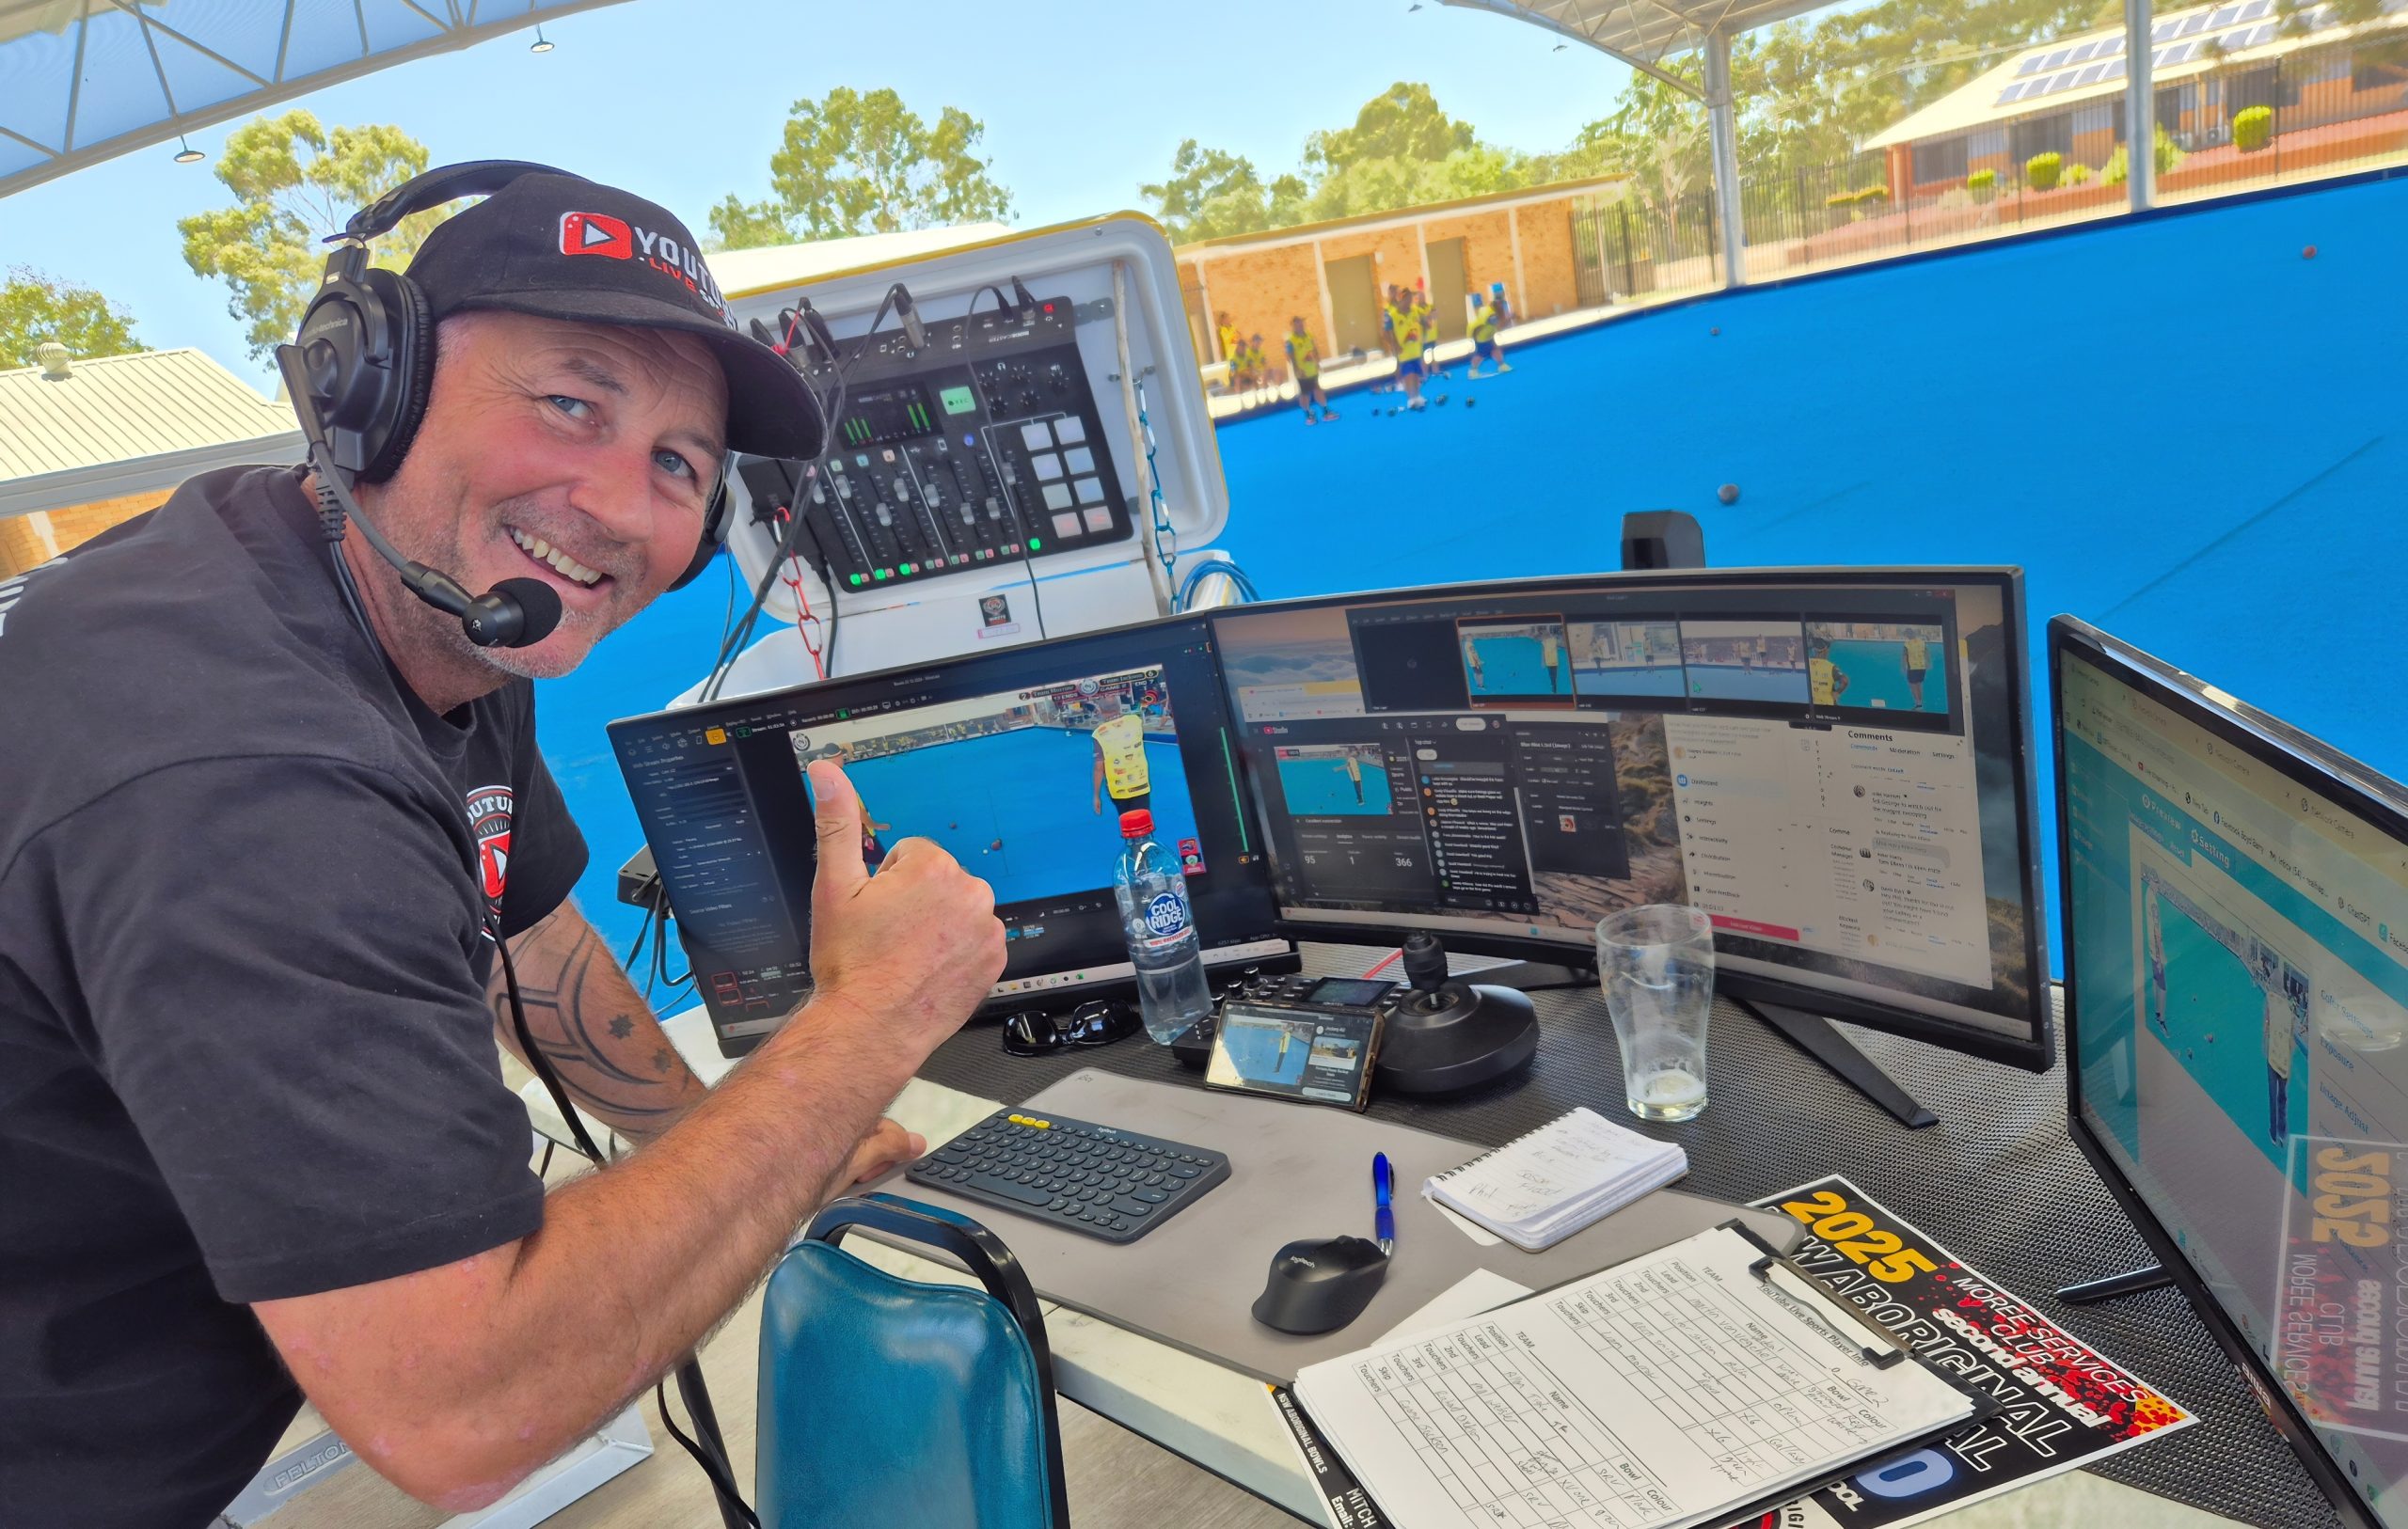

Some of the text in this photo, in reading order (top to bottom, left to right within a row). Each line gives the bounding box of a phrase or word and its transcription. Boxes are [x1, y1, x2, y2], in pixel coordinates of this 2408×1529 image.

[649, 257, 697, 295] LIVE
[1847, 730, 1893, 742] Comments
[1889, 747, 1921, 755] Moderation
[1932, 751, 1955, 760] Settings
[1691, 779, 1719, 787] Dashboard
[2150, 800, 2181, 830] Preview
[1305, 855, 1316, 864] 95
[1350, 856, 1355, 865] 1
[1395, 858, 1413, 867] 366
[2199, 836, 2229, 868] Setting
[1151, 898, 1182, 930] COOL RIDGE
[2348, 904, 2370, 926] ChatGPT
[2320, 1036, 2354, 1073] Exposure
[2320, 1080, 2369, 1136] Image Adjust
[1781, 1190, 1939, 1283] 2025
[1290, 1255, 1315, 1269] logitech
[1671, 1261, 1697, 1284] Position
[1641, 1269, 1670, 1295] Touchers
[1660, 1270, 1679, 1286] Lead
[1702, 1266, 1723, 1283] TEAM
[1604, 1292, 1620, 1304] 3rd
[1612, 1279, 1641, 1305] Touchers
[1633, 1281, 1648, 1294] 2nd
[1554, 1300, 1582, 1327] Touchers
[1573, 1301, 1590, 1316] Skip
[1584, 1289, 1611, 1316] Touchers
[1746, 1321, 1768, 1340] Name
[1760, 1281, 1869, 1367] YouTube Live Sports Player Info
[1455, 1332, 1481, 1361] Touchers
[1474, 1332, 1492, 1349] Lead
[1485, 1325, 1509, 1349] Position
[1515, 1331, 1536, 1349] TEAM
[1953, 1276, 2147, 1404] MOREE SERVICES
[1990, 1323, 2056, 1365] CLUB
[1411, 1356, 1424, 1369] 3rd
[1422, 1343, 1450, 1371] Touchers
[1444, 1345, 1459, 1360] 2nd
[1359, 1363, 1384, 1394] Touchers
[1378, 1365, 1392, 1381] Skip
[1392, 1352, 1416, 1382] Touchers
[1932, 1307, 2113, 1428] second annual
[1827, 1385, 1851, 1403] Bowl
[2242, 1362, 2272, 1410] aiwa
[1548, 1390, 1570, 1411] Name
[1858, 1409, 1888, 1430] Colour
[1277, 1393, 1328, 1474] NSW ABORIGINAL BOWLS
[1619, 1462, 1642, 1482] Bowl
[1331, 1495, 1354, 1529] Email:
[1346, 1487, 1378, 1529] MITCH
[1646, 1489, 1673, 1512] Colour
